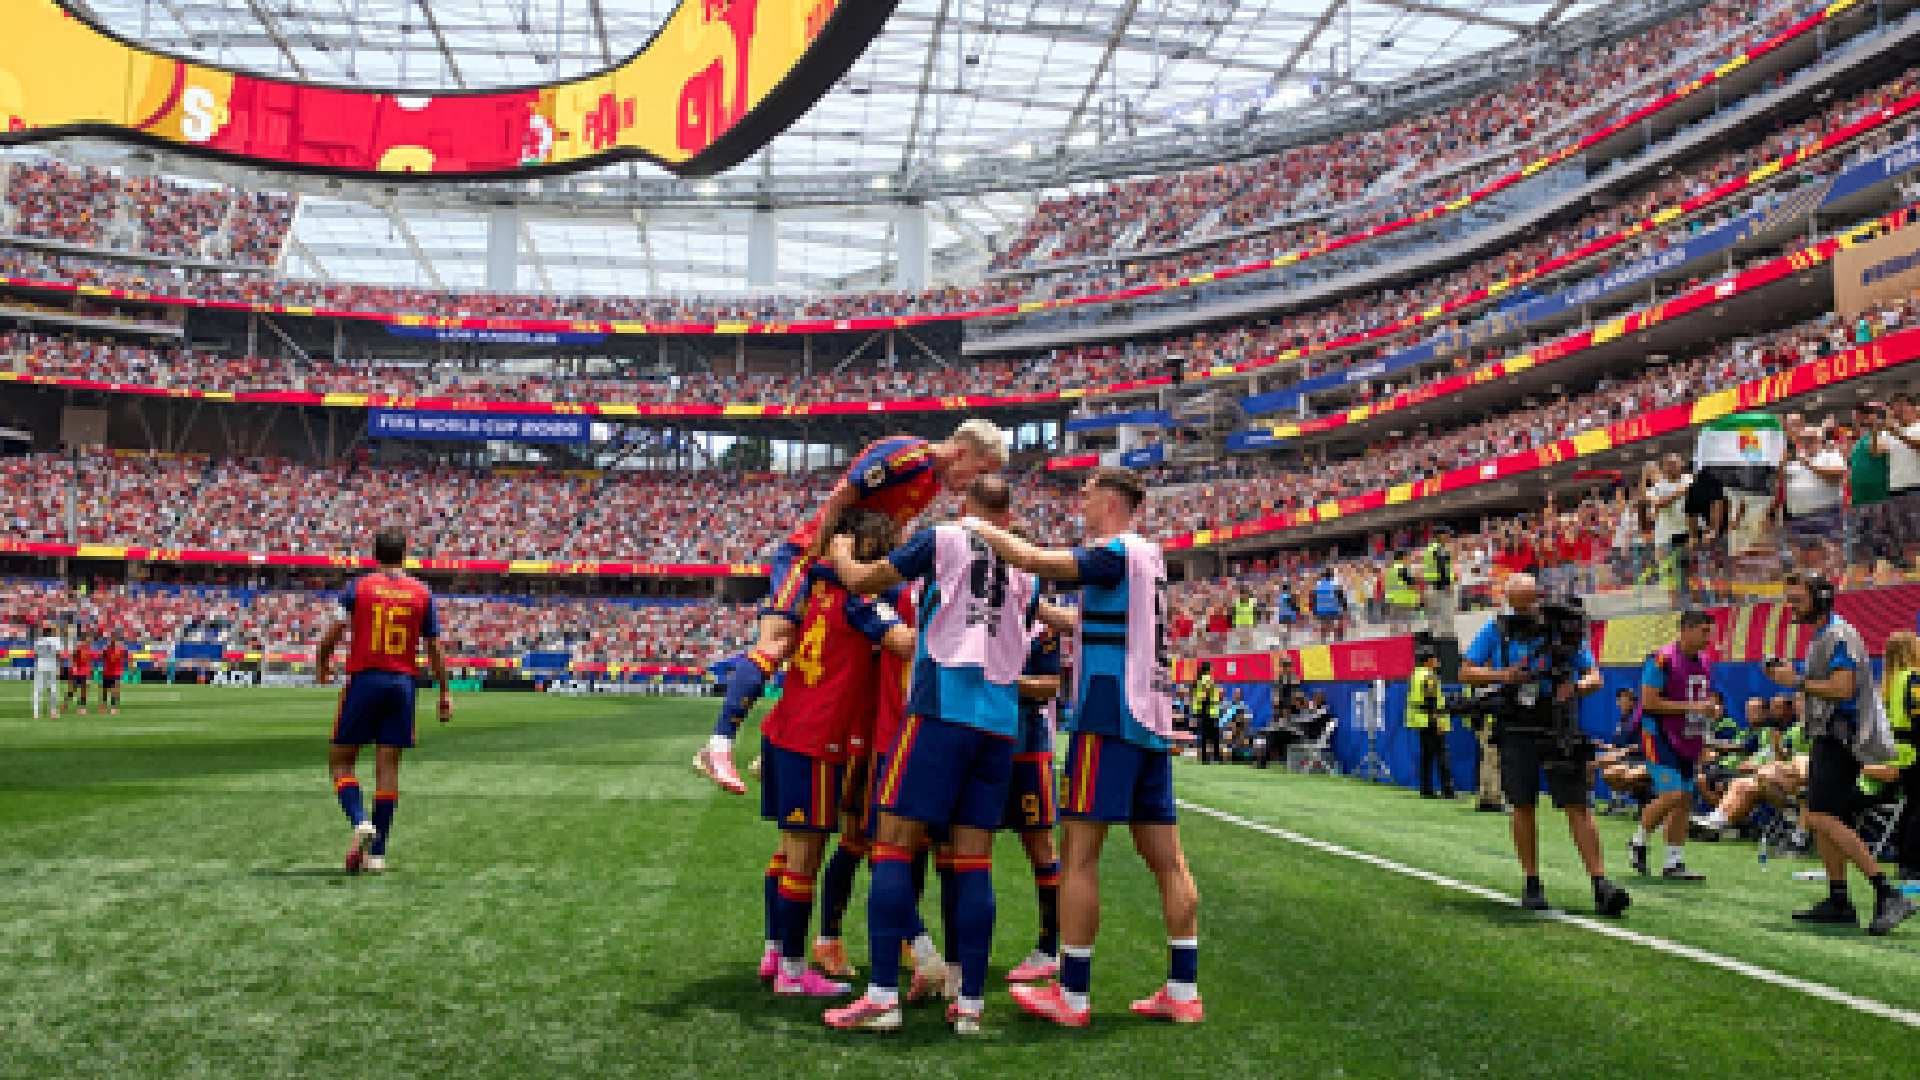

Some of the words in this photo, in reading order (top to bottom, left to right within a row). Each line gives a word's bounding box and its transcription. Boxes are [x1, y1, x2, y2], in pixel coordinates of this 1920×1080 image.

[1814, 345, 1887, 385] GOAL
[379, 414, 415, 430] FIFA
[419, 417, 480, 433] WORLD
[483, 419, 518, 434] CUP
[370, 604, 413, 655] 16
